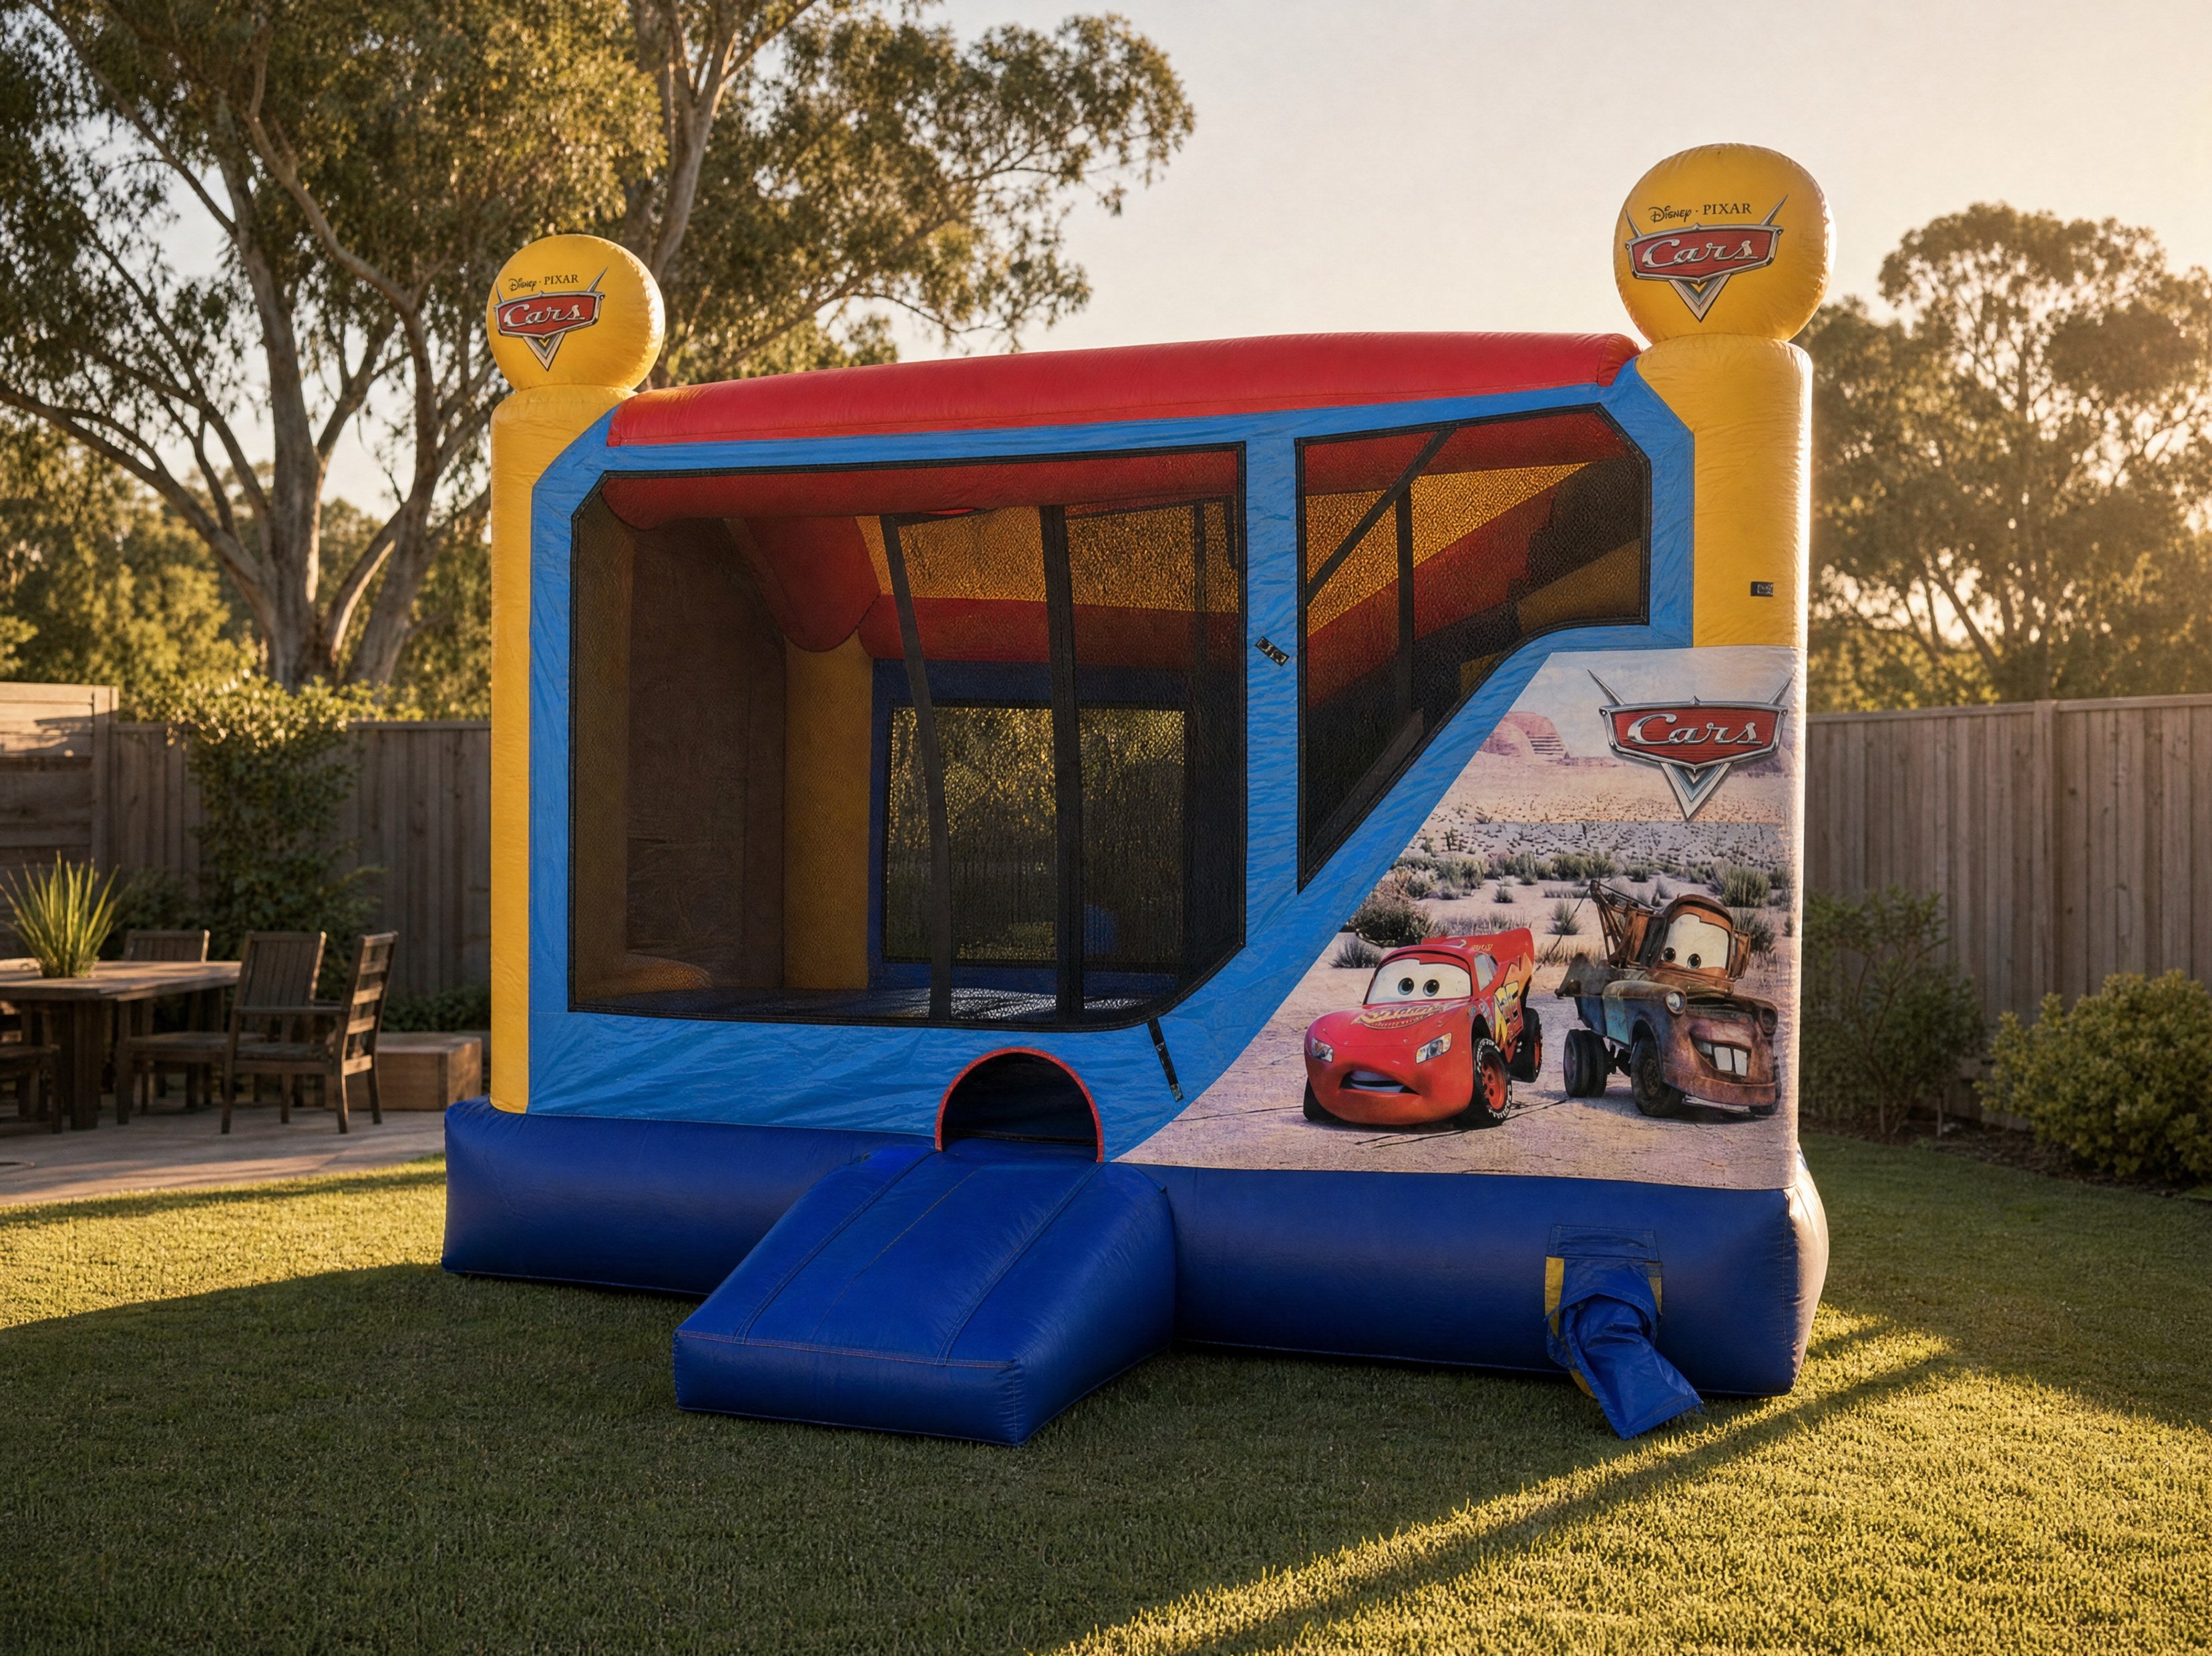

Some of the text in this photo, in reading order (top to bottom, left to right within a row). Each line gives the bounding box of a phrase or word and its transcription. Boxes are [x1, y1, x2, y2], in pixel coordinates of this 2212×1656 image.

[1648, 203, 1752, 223] Disney PIXAR
[1642, 238, 1759, 268] Cars
[508, 274, 578, 291] Disney PIXAR
[504, 303, 585, 327] Cars
[1627, 713, 1763, 746] Cars
